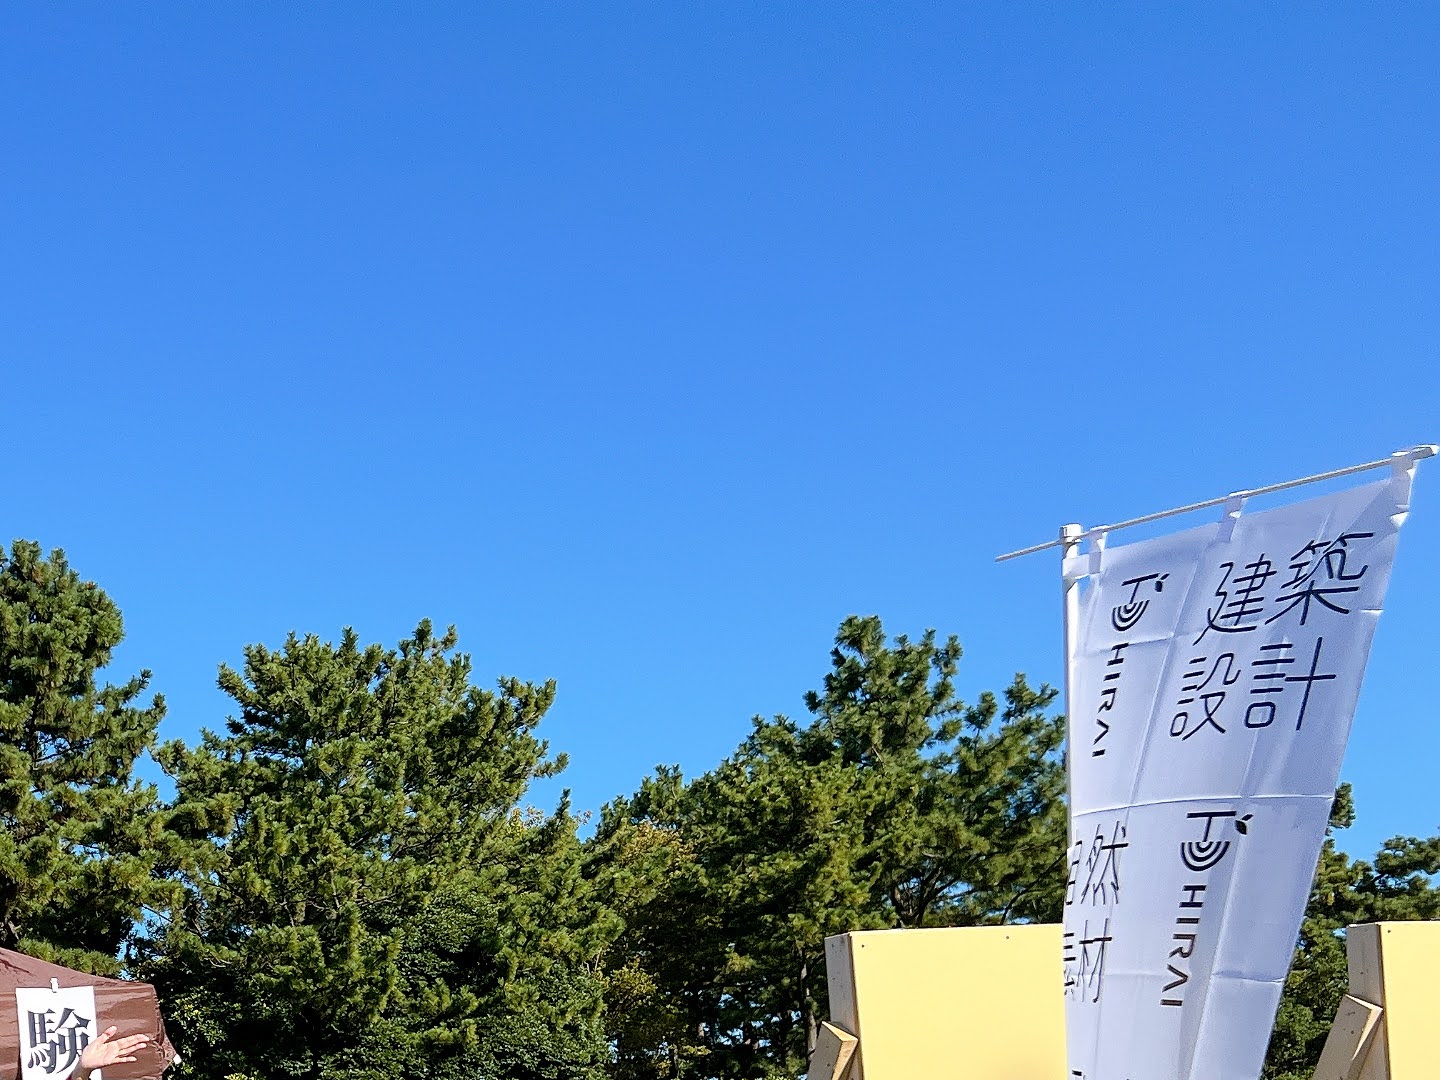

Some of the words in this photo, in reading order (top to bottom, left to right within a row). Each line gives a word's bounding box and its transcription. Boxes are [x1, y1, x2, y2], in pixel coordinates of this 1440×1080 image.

[1192, 532, 1374, 646] 建築
[1092, 642, 1129, 757] HIRAI
[1169, 636, 1337, 741] 設計
[1160, 885, 1207, 1006] HIRAI
